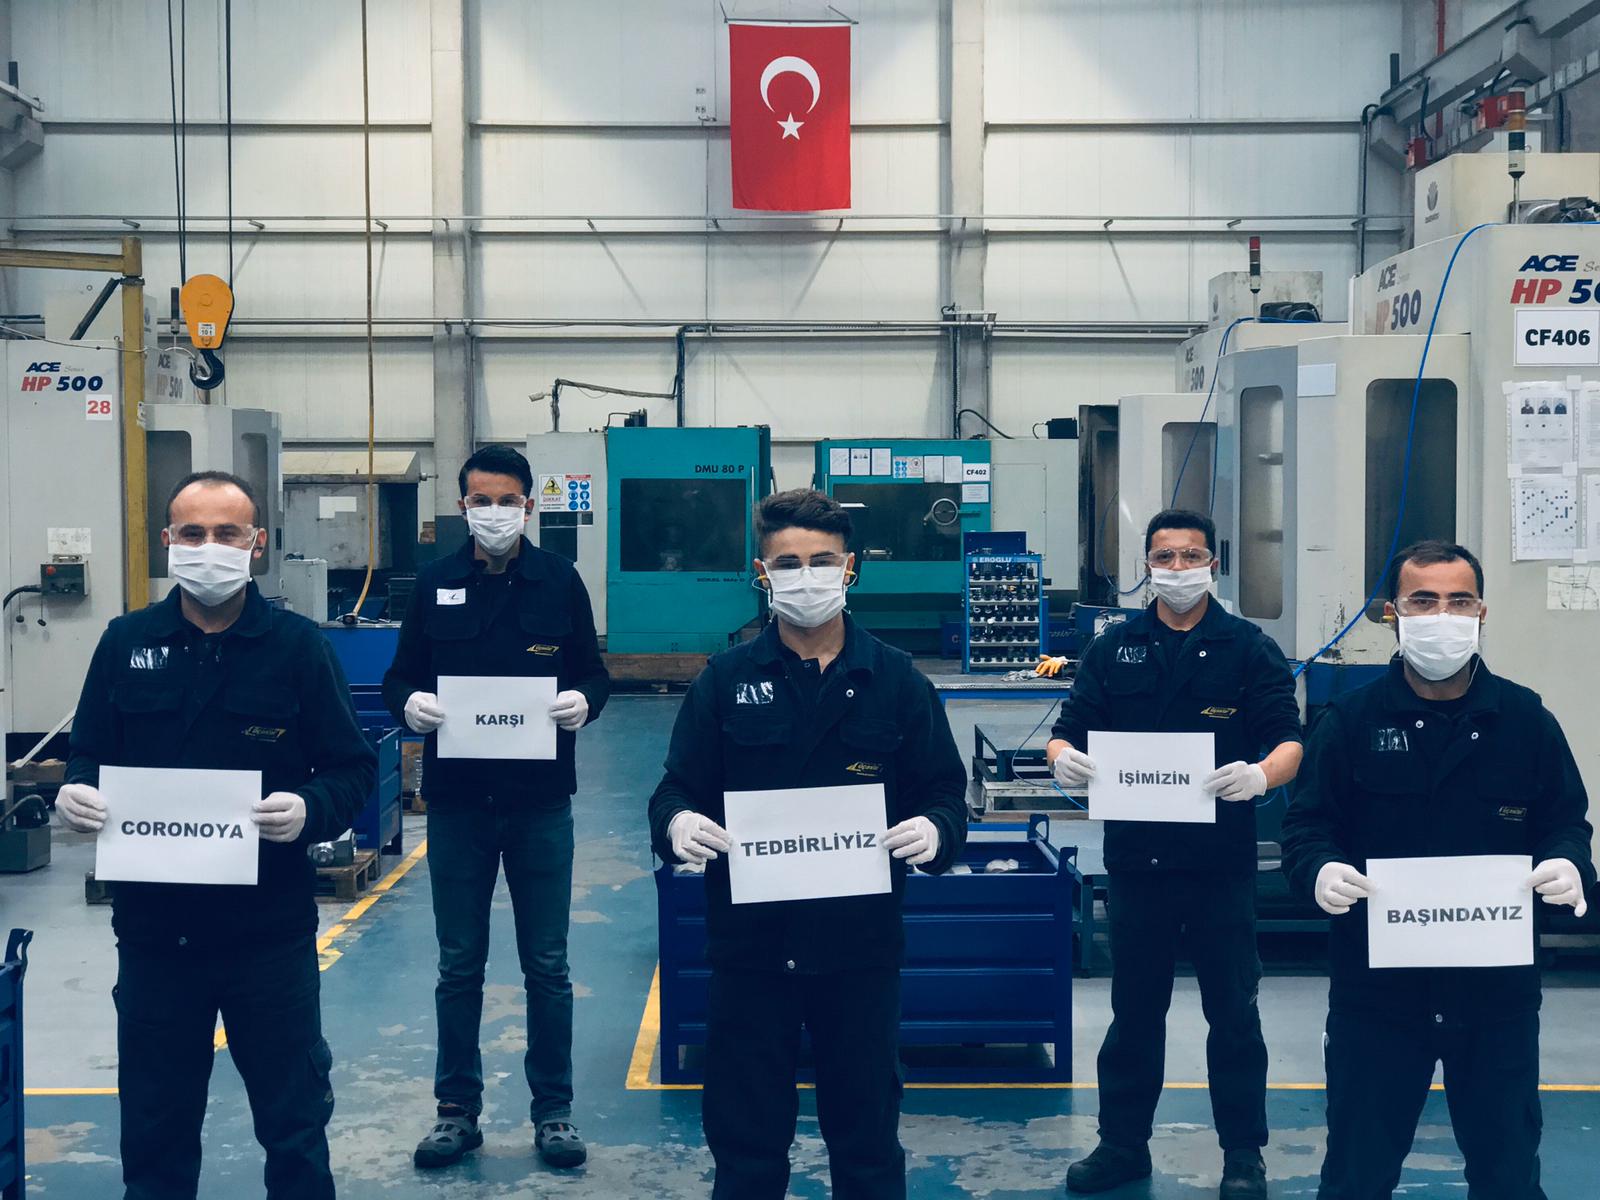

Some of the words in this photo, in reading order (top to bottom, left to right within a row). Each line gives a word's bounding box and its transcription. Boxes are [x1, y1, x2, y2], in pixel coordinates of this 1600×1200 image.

[1518, 254, 1580, 272] ACE
[1377, 263, 1398, 292] ACE
[1510, 278, 1562, 304] HP
[1391, 288, 1422, 331] 500
[1525, 329, 1591, 346] CF406
[25, 361, 62, 373] ACE
[21, 376, 52, 391] HP
[56, 375, 103, 391] 500
[87, 400, 111, 415] 28
[695, 464, 719, 473] DMU
[722, 464, 735, 473] 80
[738, 464, 745, 473] P
[475, 714, 524, 727] KARŞI
[1119, 770, 1190, 787] İŞİMİZİN
[121, 821, 243, 839] CORONOYA
[740, 831, 877, 857] TEDBİRLİYİZ
[1387, 906, 1523, 926] BAŞINDAYIZ
